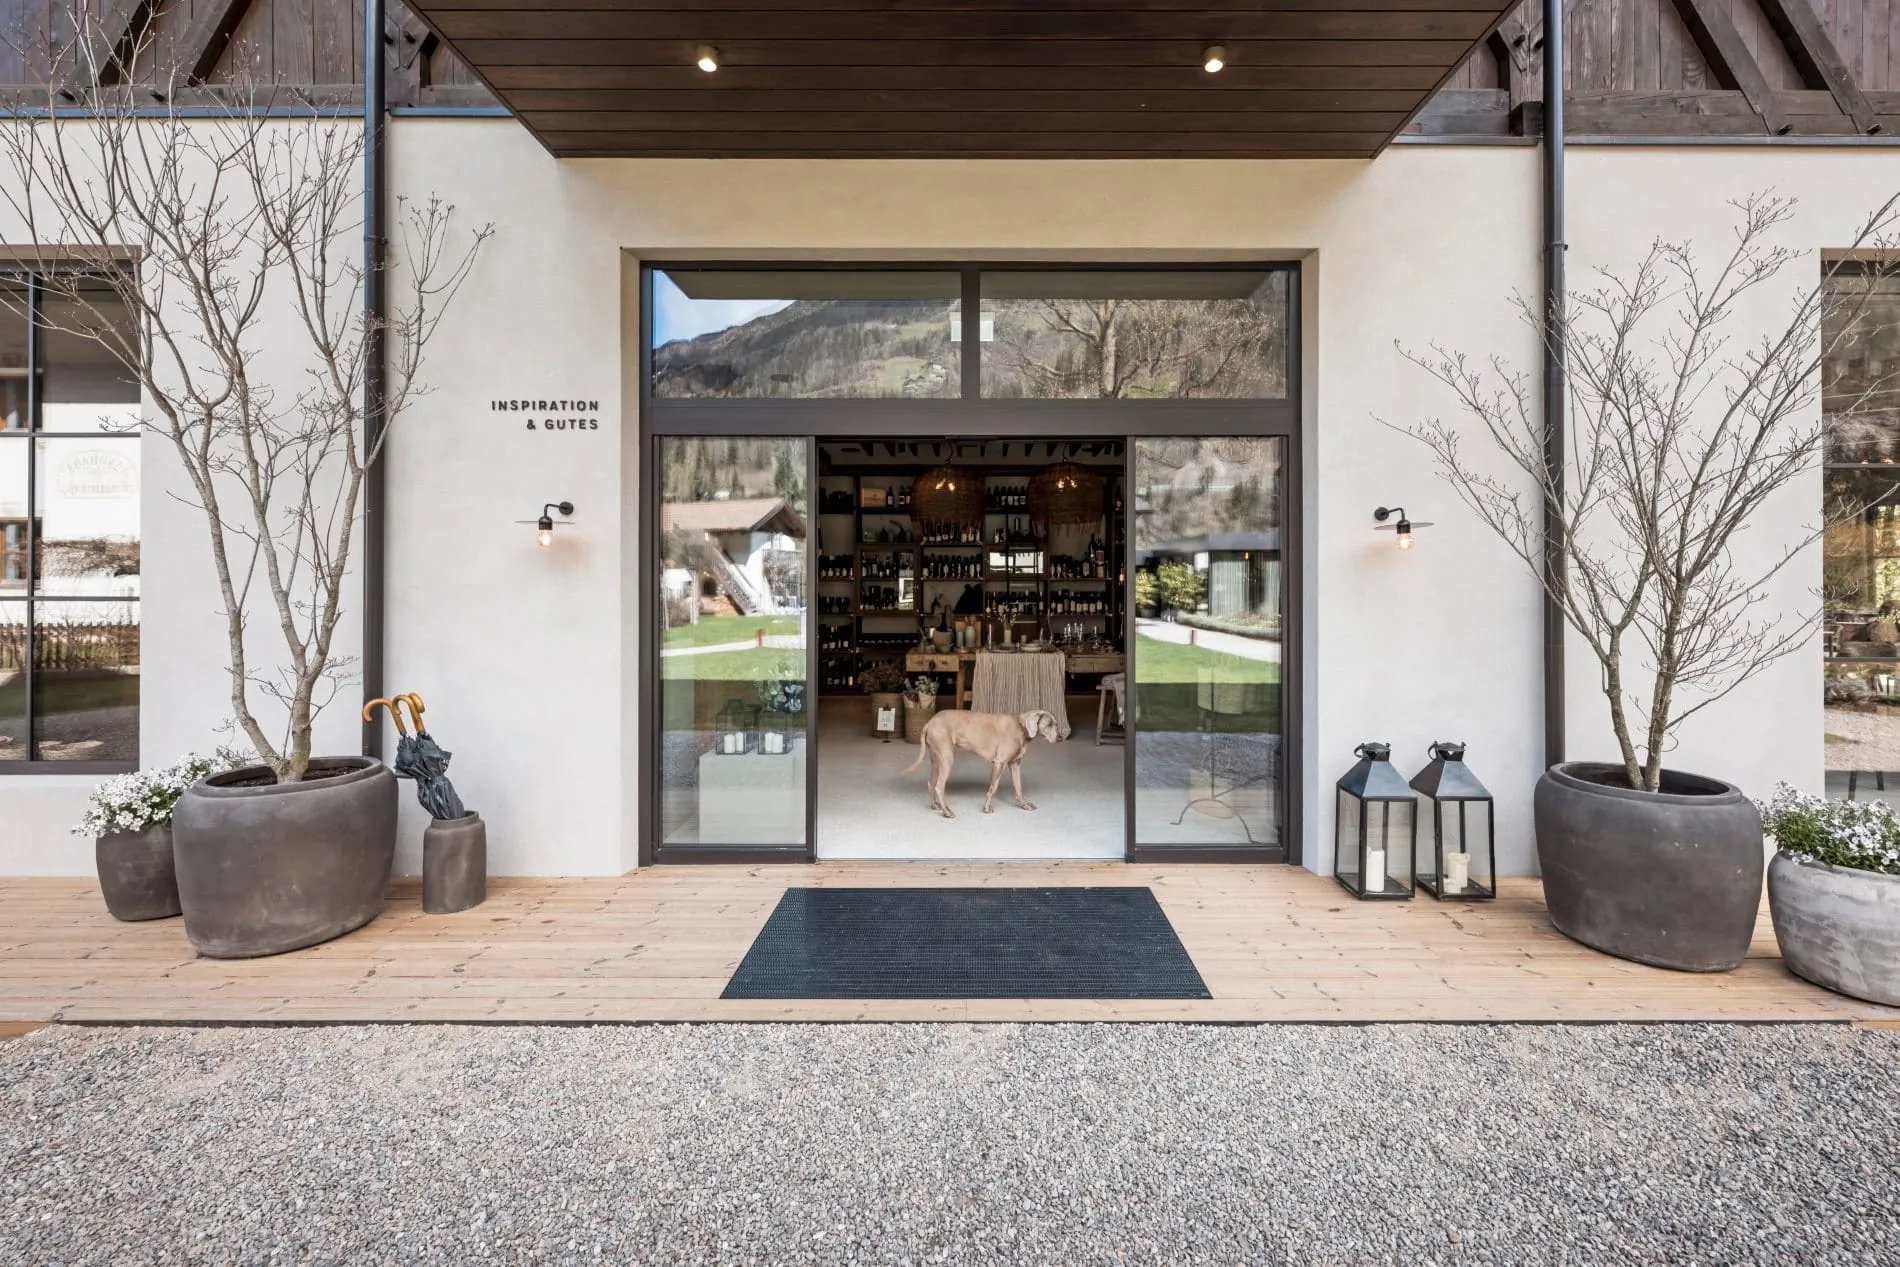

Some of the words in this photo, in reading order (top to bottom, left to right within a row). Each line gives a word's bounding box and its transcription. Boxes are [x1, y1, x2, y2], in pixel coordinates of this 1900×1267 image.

[491, 399, 599, 412] INSPIRATION
[526, 418, 537, 430] &
[544, 418, 598, 430] GUTES
